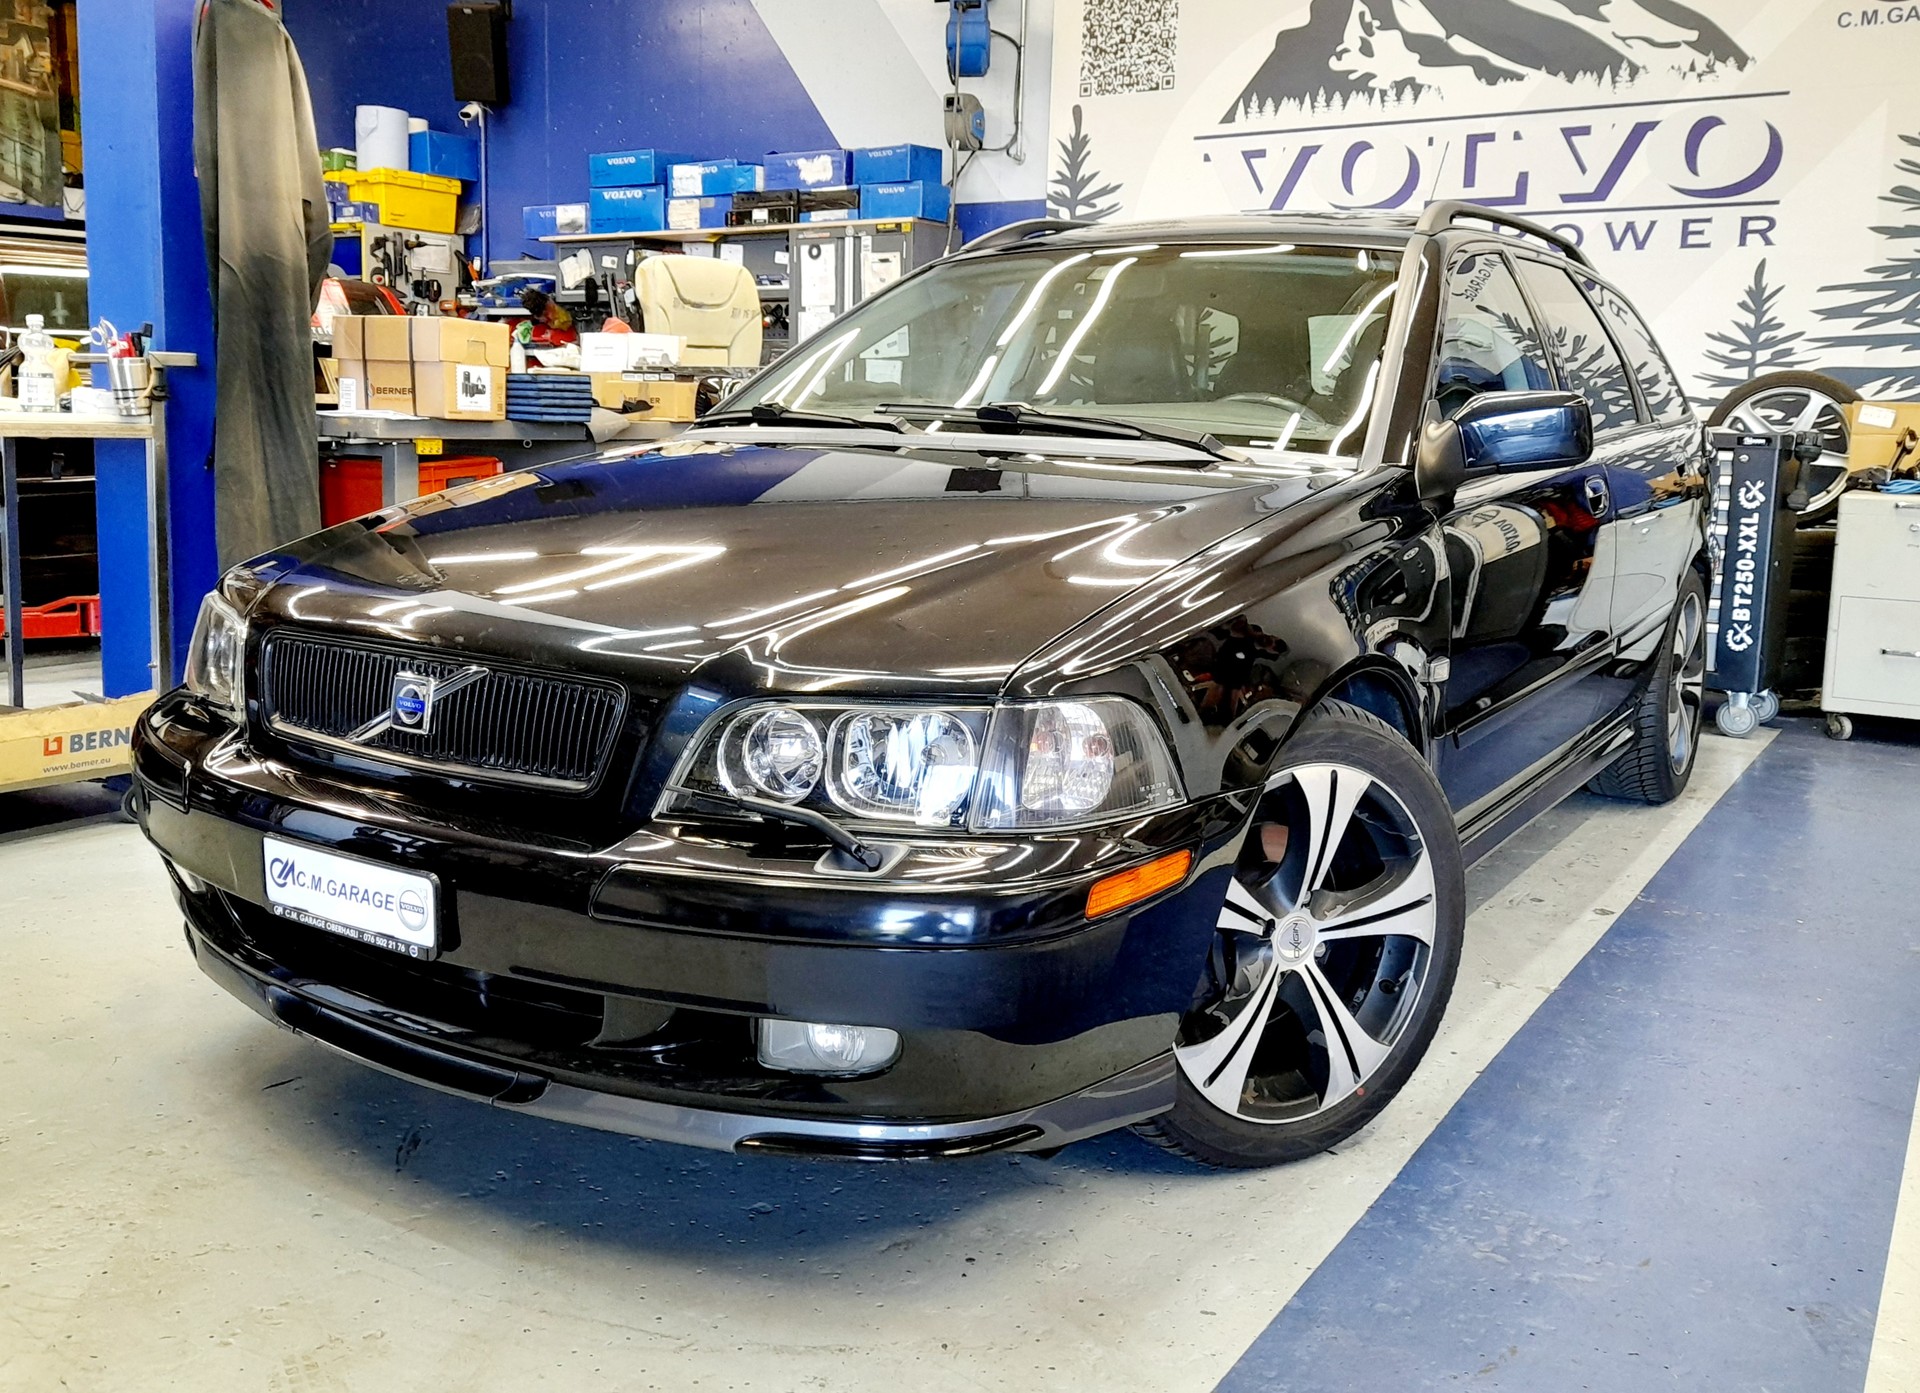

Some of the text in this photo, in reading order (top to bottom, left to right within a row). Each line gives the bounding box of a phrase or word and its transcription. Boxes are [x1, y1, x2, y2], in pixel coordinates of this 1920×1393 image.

[1837, 5, 1920, 28] C.M.GA
[868, 149, 893, 158] VOLVO
[607, 156, 636, 166] VOLVO
[1203, 114, 1784, 211] VOLVO
[602, 189, 643, 200] VOLVO
[878, 186, 905, 195] VOLVO
[376, 386, 414, 396] BERNER
[1732, 512, 1759, 622] BT250-XXL
[399, 699, 422, 709] VOLVO
[296, 871, 395, 912] C.M.GARAGE
[400, 902, 424, 914] VOLVO
[299, 913, 325, 929] GARAGE
[325, 922, 359, 938] OBERHASLI
[363, 933, 375, 944] 076
[375, 937, 387, 947] 502
[387, 940, 396, 950] 21
[397, 942, 406, 953] 76
